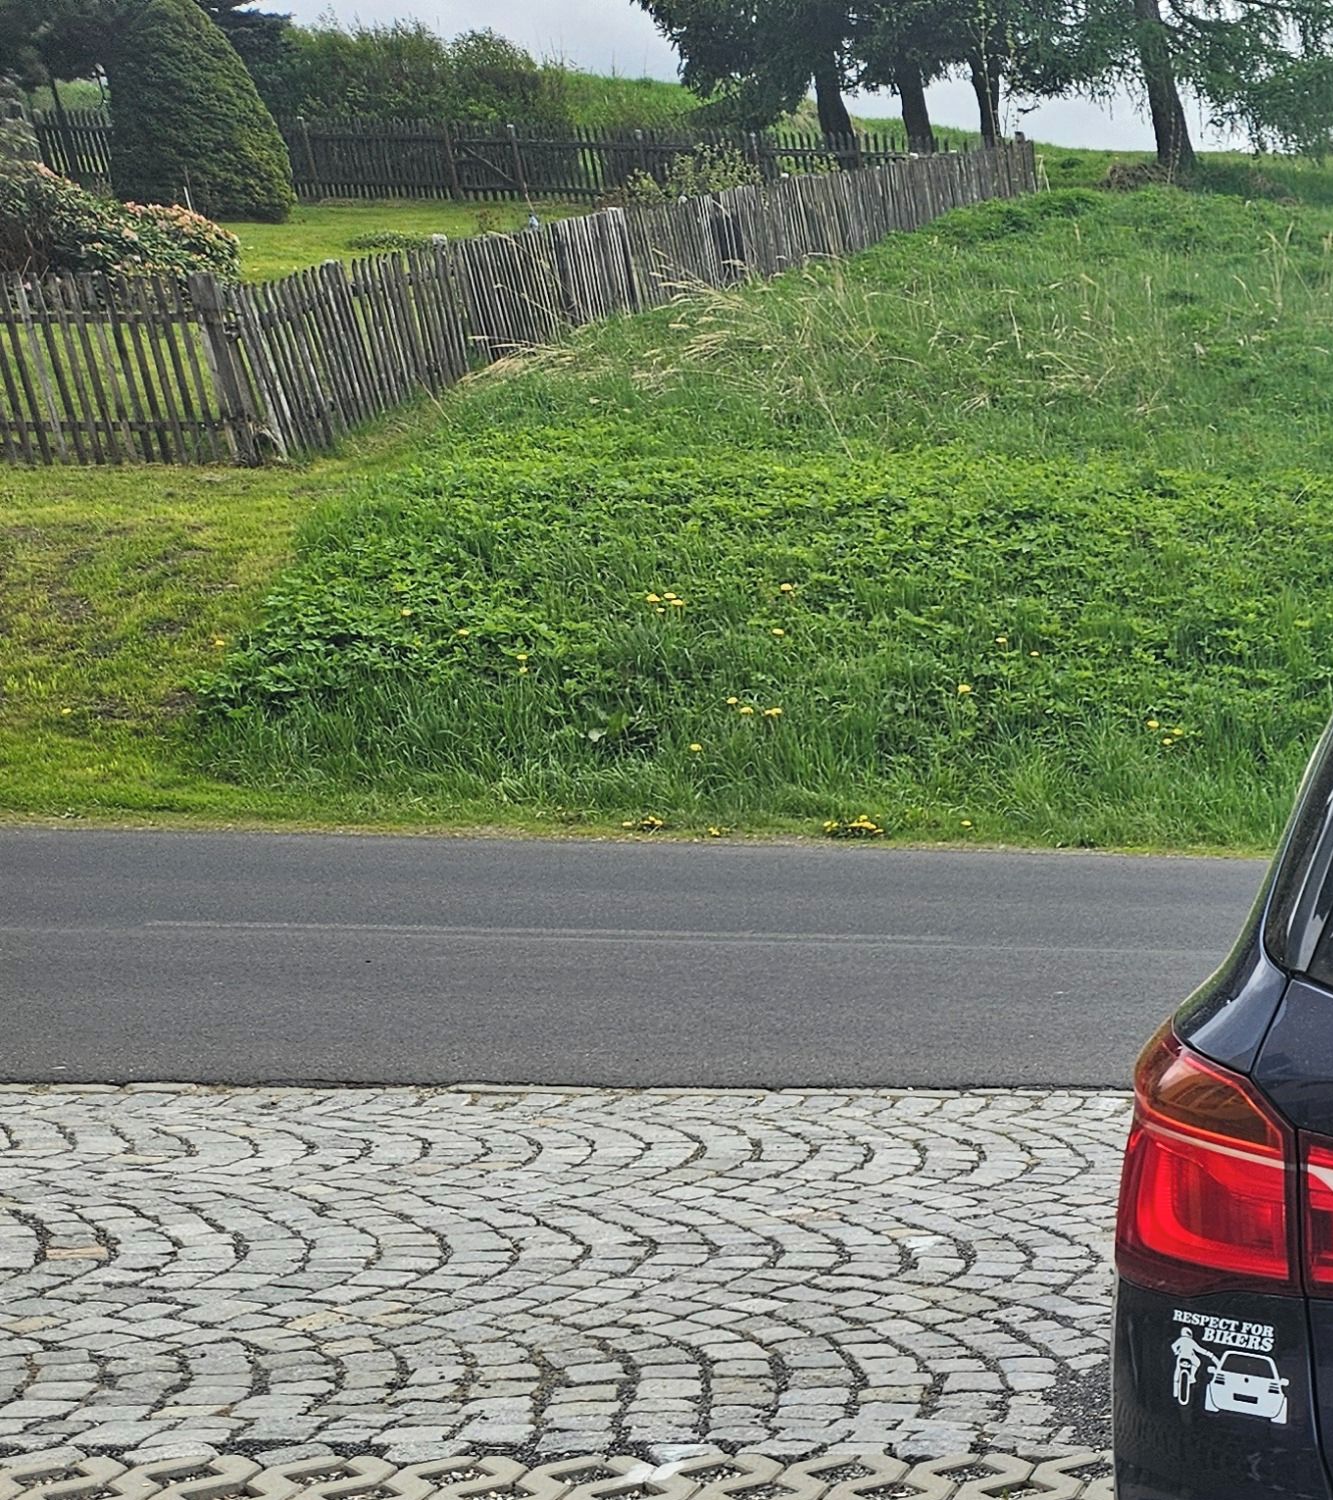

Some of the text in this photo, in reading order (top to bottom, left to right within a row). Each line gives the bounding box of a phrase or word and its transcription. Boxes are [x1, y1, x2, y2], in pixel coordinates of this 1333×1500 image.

[1172, 1309, 1274, 1338] RESPECT FOR
[1201, 1328, 1275, 1352] BIKERS
